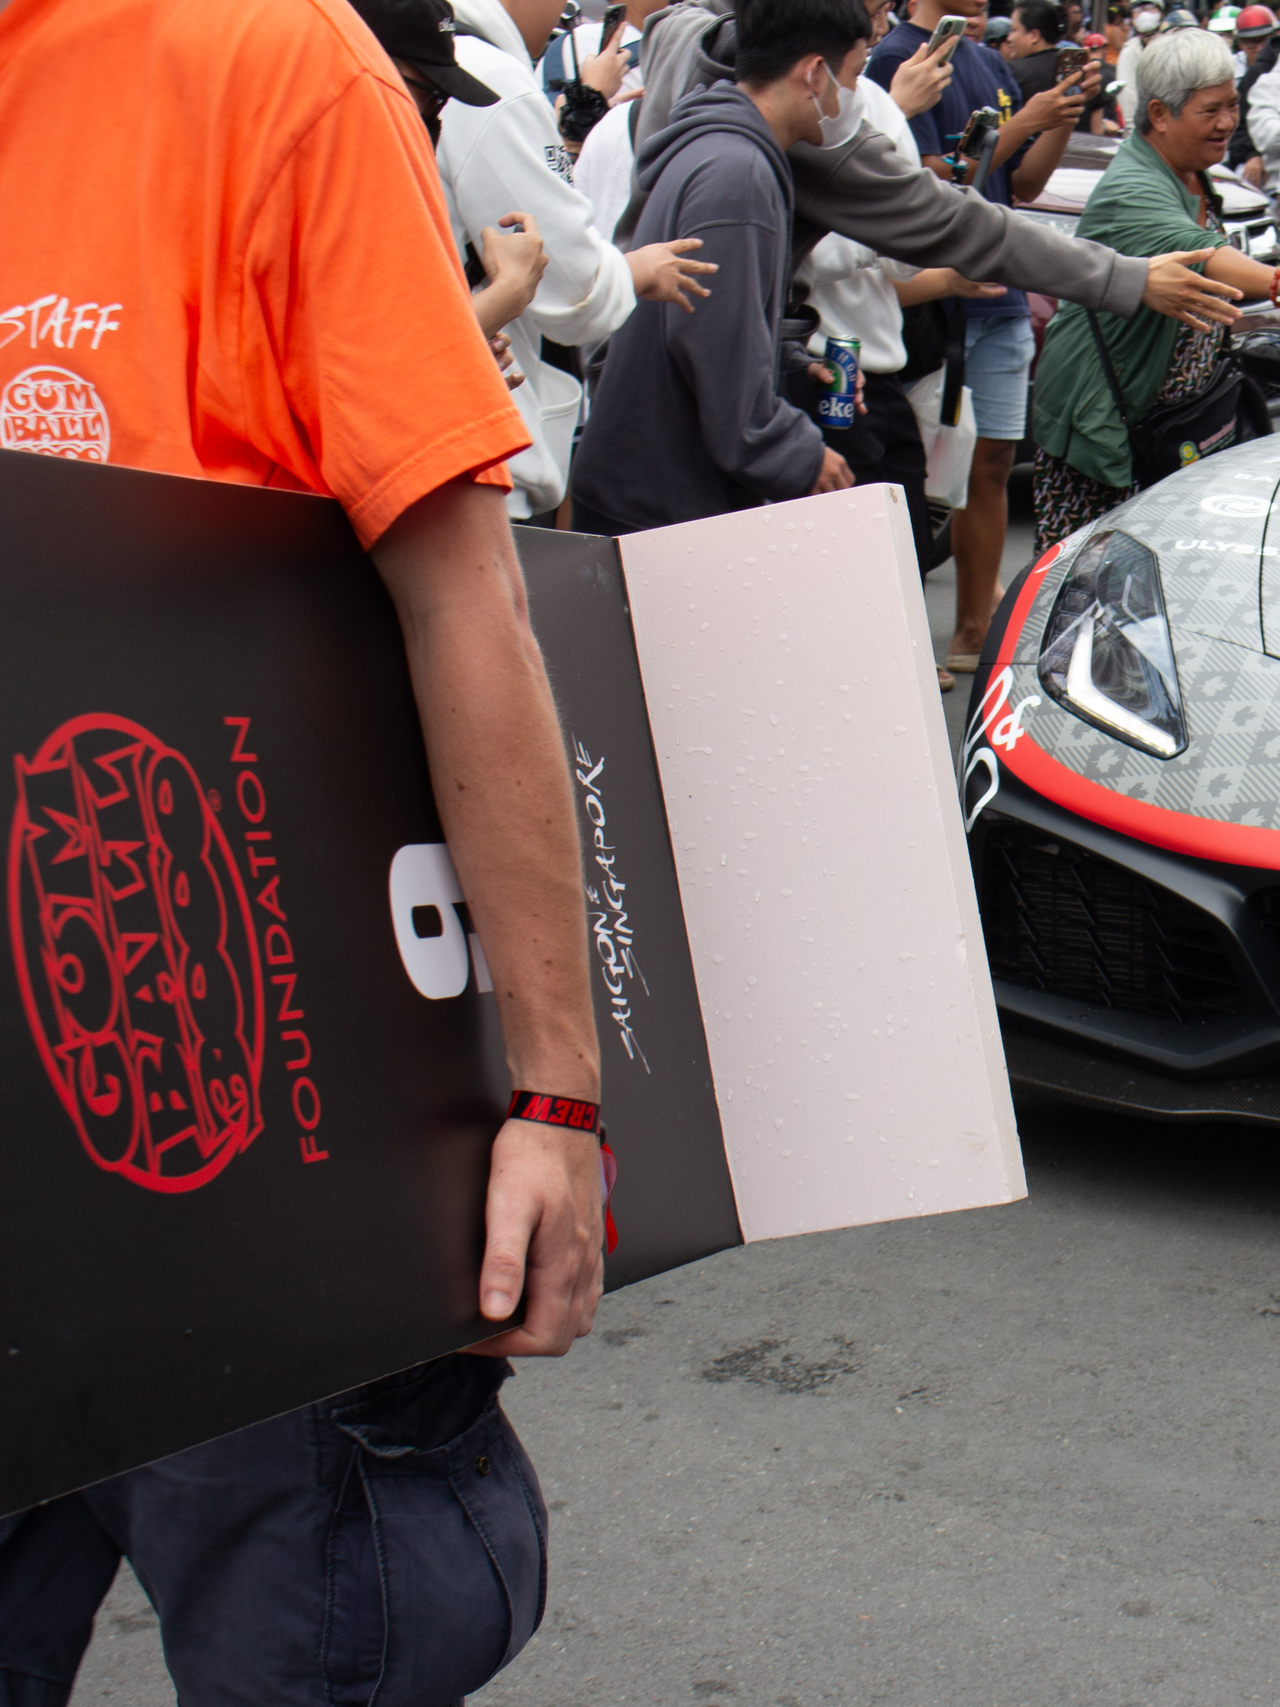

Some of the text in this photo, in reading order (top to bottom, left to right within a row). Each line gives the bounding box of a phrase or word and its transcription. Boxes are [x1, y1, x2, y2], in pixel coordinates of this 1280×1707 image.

[0, 293, 124, 350] STAFF
[4, 413, 104, 443] BALL
[70, 738, 203, 1160] BALL
[145, 746, 265, 1158] 3000
[223, 716, 330, 1164] FOUNDATION
[571, 731, 650, 997] SINGAPORE
[587, 911, 651, 1075] SAIGON
[520, 1094, 597, 1130] CREW
